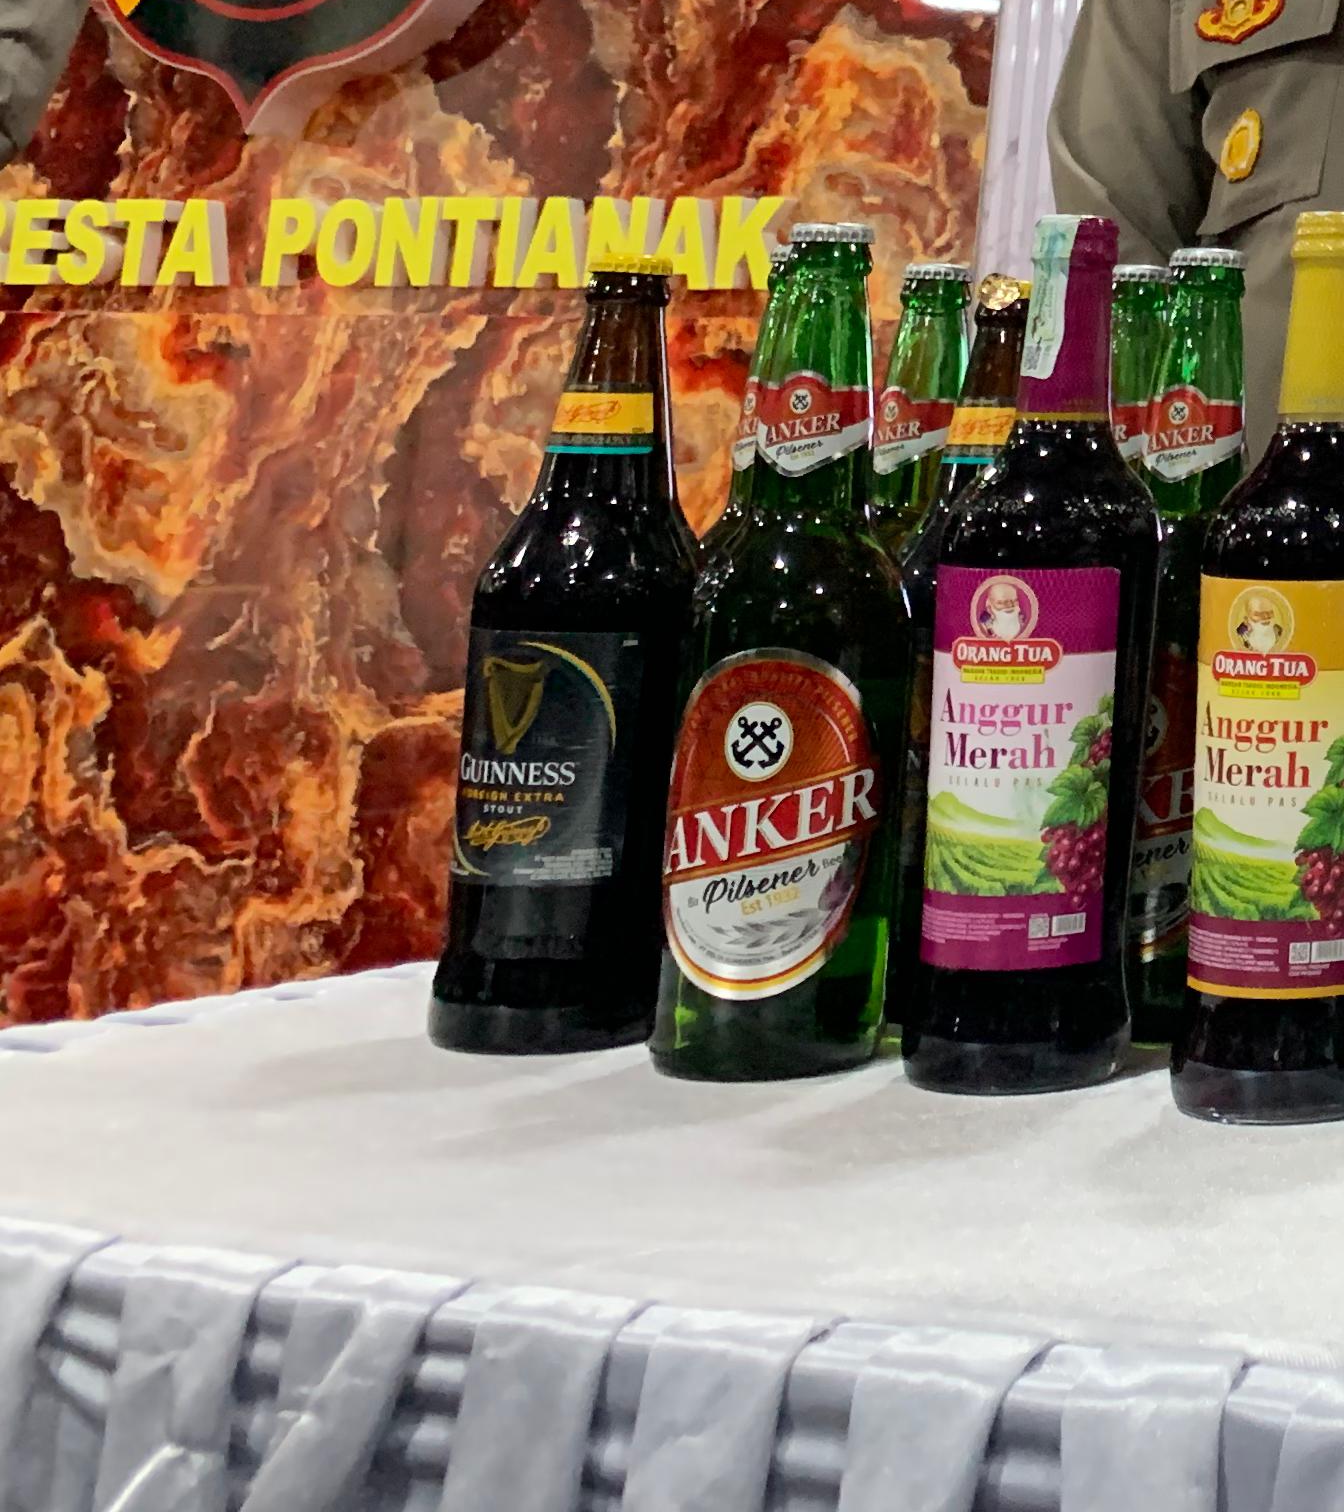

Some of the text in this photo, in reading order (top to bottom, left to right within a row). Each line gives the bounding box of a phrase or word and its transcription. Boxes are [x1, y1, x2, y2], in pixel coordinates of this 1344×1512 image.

[0, 198, 786, 288] ESTA PONTIANAK
[767, 412, 841, 443] ANKER
[1151, 423, 1215, 452] ANKER
[776, 439, 823, 459] Pilsener
[957, 643, 1053, 664] ORANG TUA
[1215, 655, 1309, 677] ORANG TUA
[941, 688, 1074, 737] Anggur
[1201, 701, 1329, 753] Anggur
[944, 731, 1056, 769] Merah
[461, 752, 576, 786] GUINNESS
[1013, 776, 1043, 787] PAS
[1203, 746, 1312, 788] Merah
[483, 803, 523, 814] STOUT
[514, 790, 565, 802] EXTRA
[1268, 796, 1298, 807] PAS
[668, 768, 878, 873] ANKER
[703, 858, 819, 914] Pilsener
[740, 899, 762, 915] Est
